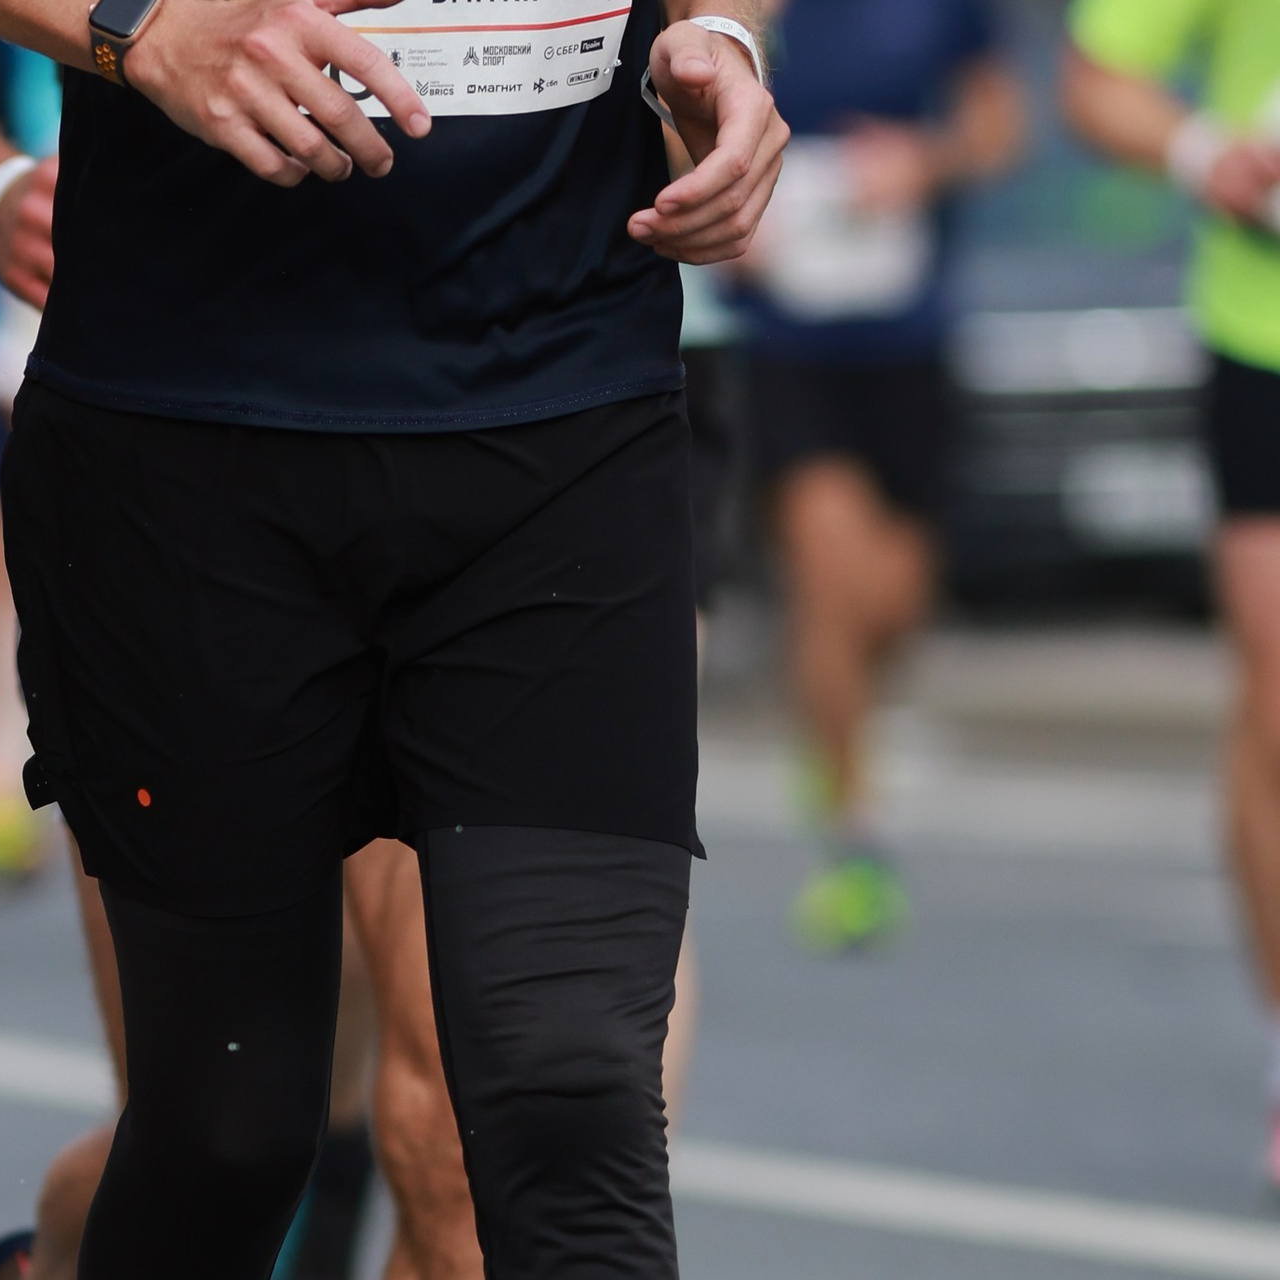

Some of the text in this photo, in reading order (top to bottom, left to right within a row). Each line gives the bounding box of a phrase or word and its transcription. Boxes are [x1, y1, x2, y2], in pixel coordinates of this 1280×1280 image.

[482, 43, 532, 56] МОСКОВСКИЙ
[556, 44, 580, 56] СБЕР
[482, 56, 505, 66] СПОРТ
[429, 88, 454, 96] BRICS
[477, 83, 523, 93] магнит
